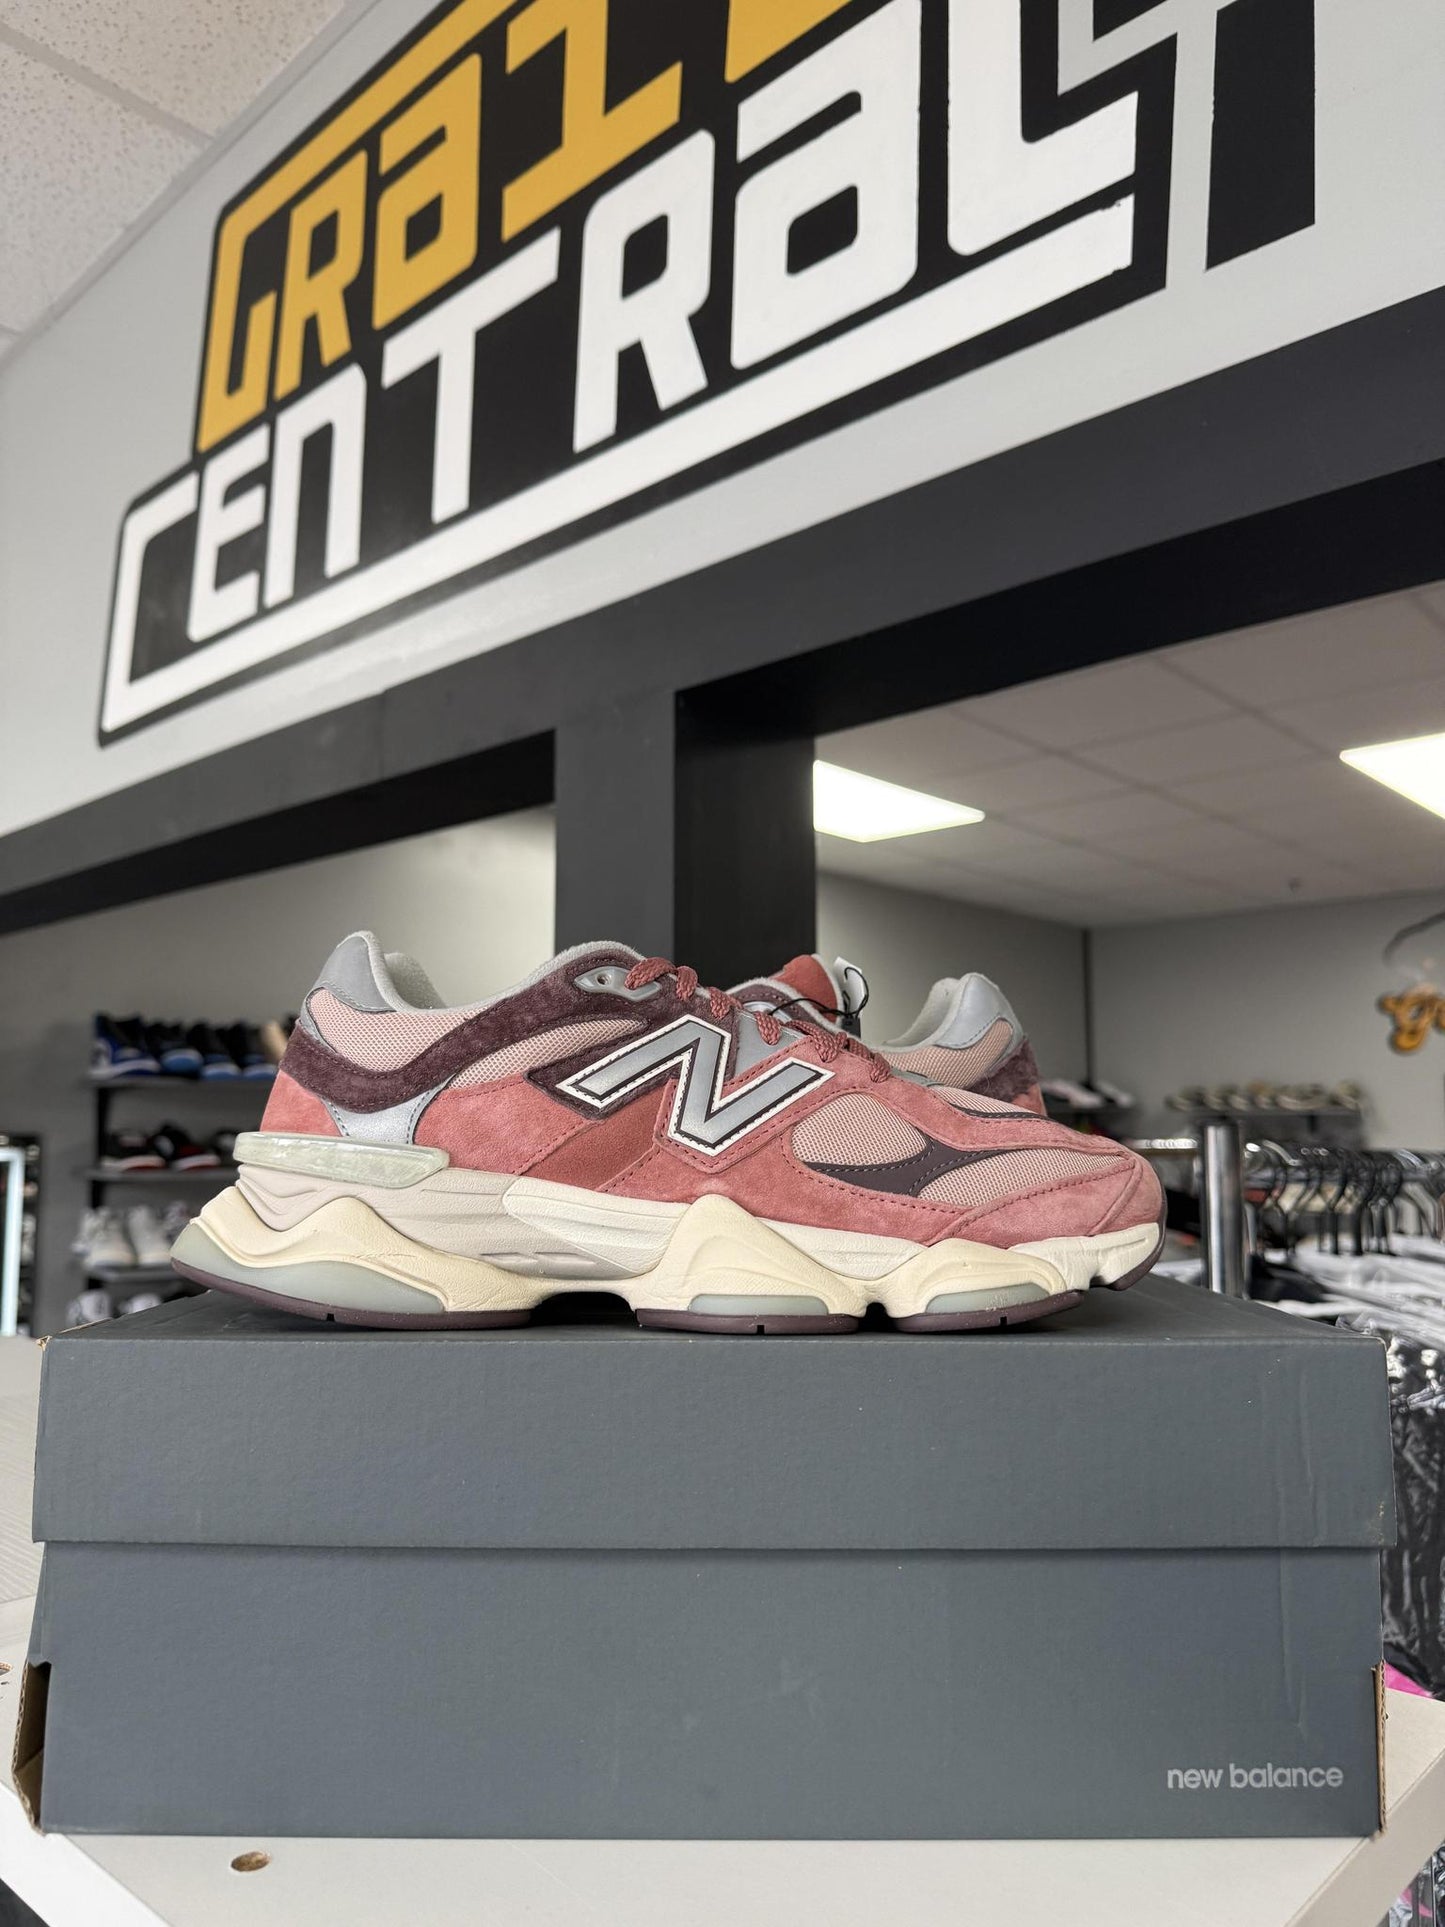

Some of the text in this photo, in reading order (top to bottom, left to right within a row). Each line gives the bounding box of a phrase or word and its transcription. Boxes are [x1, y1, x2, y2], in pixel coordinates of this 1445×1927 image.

[556, 1014, 836, 1157] N
[1167, 1762, 1344, 1789] new balance
